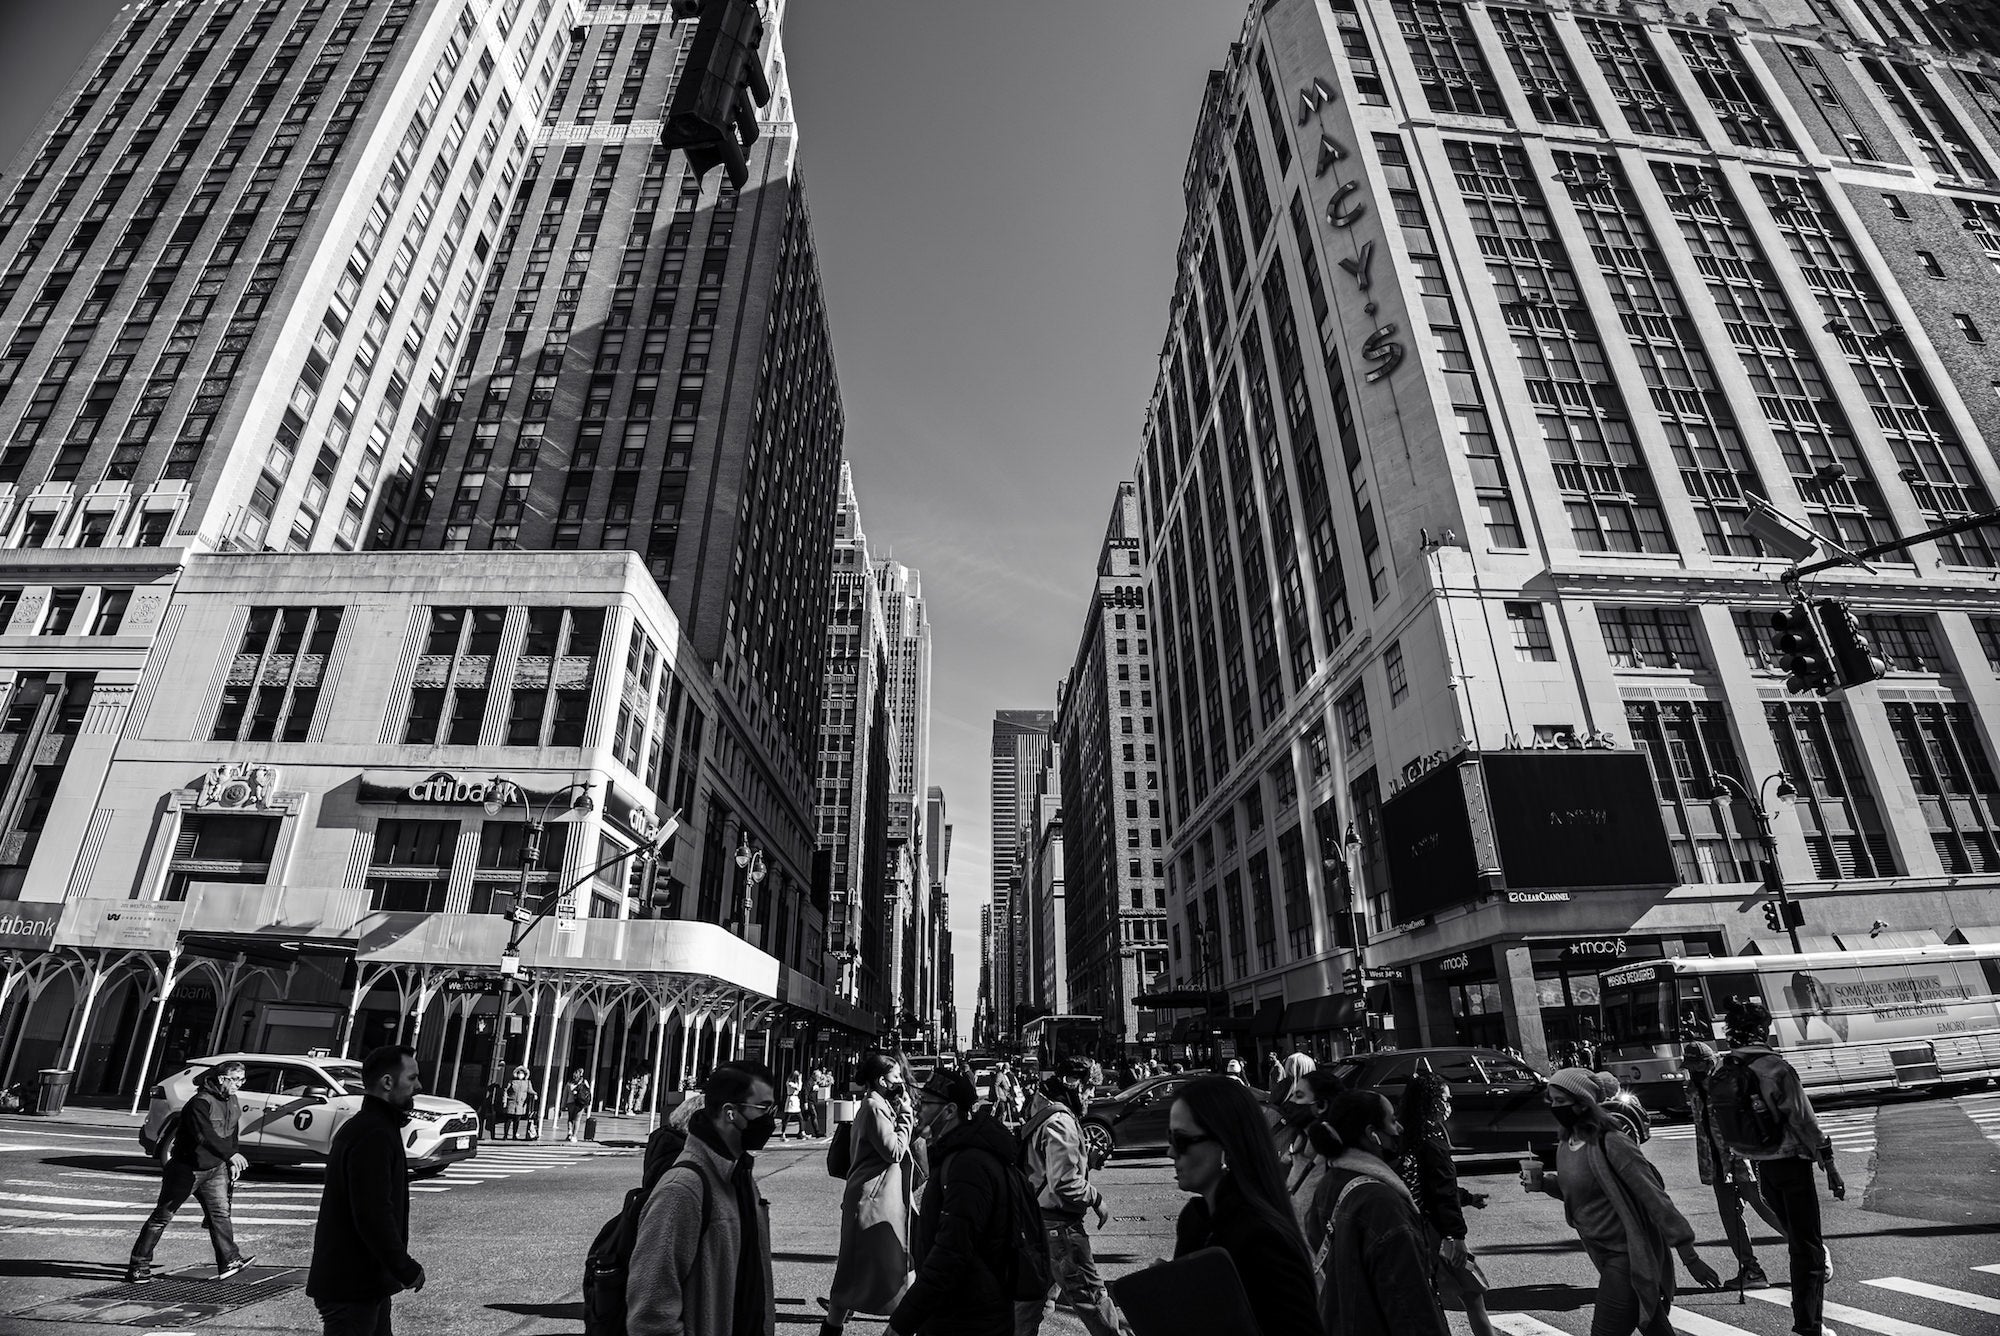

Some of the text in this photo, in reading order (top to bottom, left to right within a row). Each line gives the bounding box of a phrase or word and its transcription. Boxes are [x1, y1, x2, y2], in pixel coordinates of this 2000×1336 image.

[1298, 76, 1406, 384] MACY'S
[1505, 732, 1618, 751] MACY'S
[1388, 750, 1441, 795] MACY'S
[1580, 938, 1627, 956] macy's
[1443, 952, 1469, 971] macy's
[1369, 970, 1384, 978] West
[1395, 970, 1403, 978] St
[1606, 967, 1656, 988] MASKS REQUIRED
[1834, 985, 1864, 998] SOME
[1866, 983, 1887, 995] ARE
[1936, 1020, 1967, 1033] EMORY
[299, 1112, 311, 1129] T
